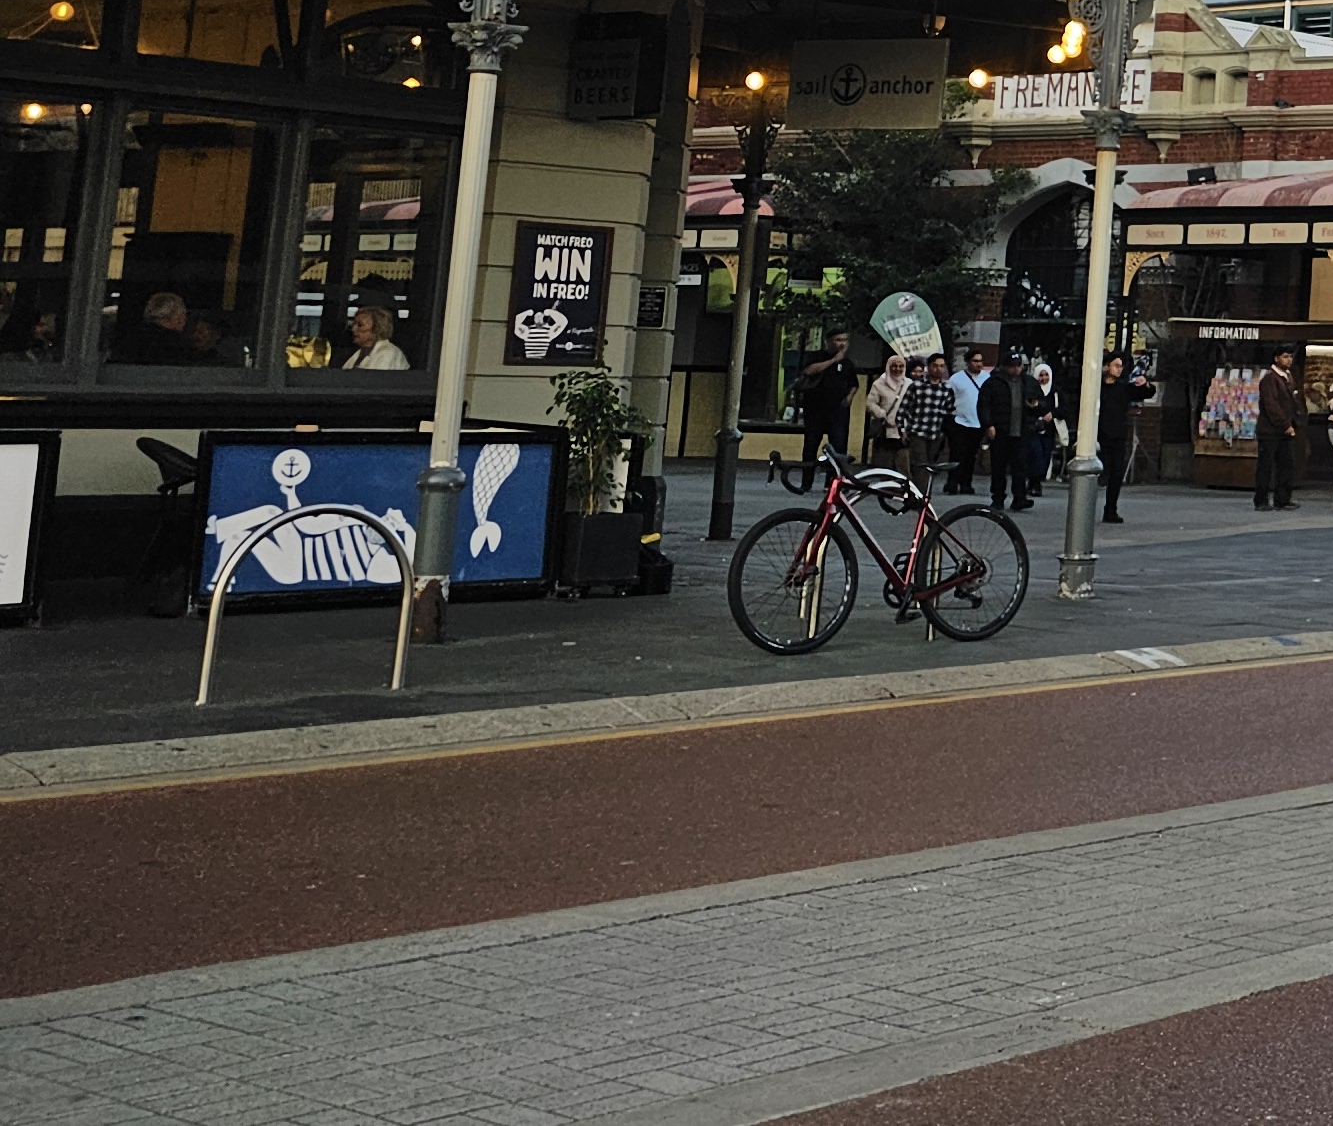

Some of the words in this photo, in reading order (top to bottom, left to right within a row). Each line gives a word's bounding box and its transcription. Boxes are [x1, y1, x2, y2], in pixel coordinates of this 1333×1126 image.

[796, 76, 826, 95] sail
[869, 76, 934, 95] anchor
[1000, 70, 1146, 109] FREMANE
[573, 86, 631, 105] BEERS
[537, 234, 568, 247] WATCH
[569, 235, 593, 248] FREO
[534, 247, 592, 282] WIN
[533, 282, 549, 298] IN
[550, 283, 589, 300] FREO!
[1199, 326, 1259, 340] INFORMATION
